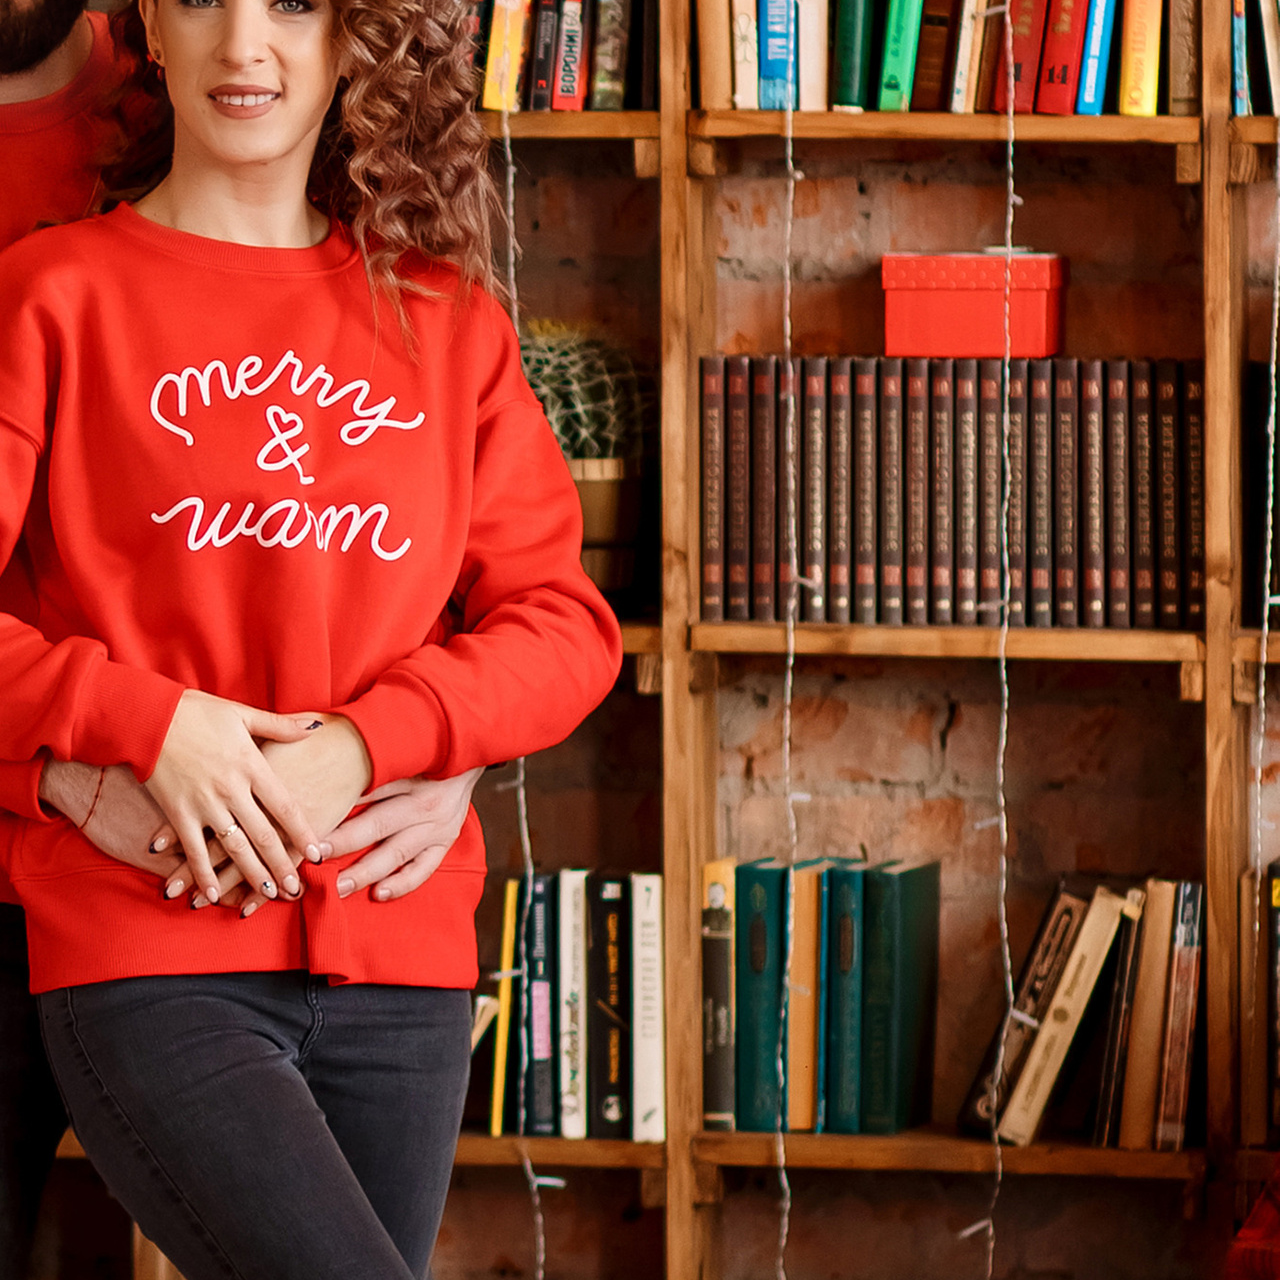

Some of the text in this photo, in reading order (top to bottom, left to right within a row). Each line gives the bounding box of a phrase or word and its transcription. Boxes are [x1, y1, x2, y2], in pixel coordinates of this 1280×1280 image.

[149, 349, 425, 446] merry
[151, 495, 413, 561] warm
[1060, 412, 1073, 554] ЭНЦИКЛОПЕДИЯ
[1137, 413, 1150, 555] ЭНЦИКЛОПЕДИЯ
[1162, 414, 1175, 557] ЭНЦИКЛОПЕДИЯ
[1189, 414, 1202, 556] ЭНЦИКЛОПЕДИЯ
